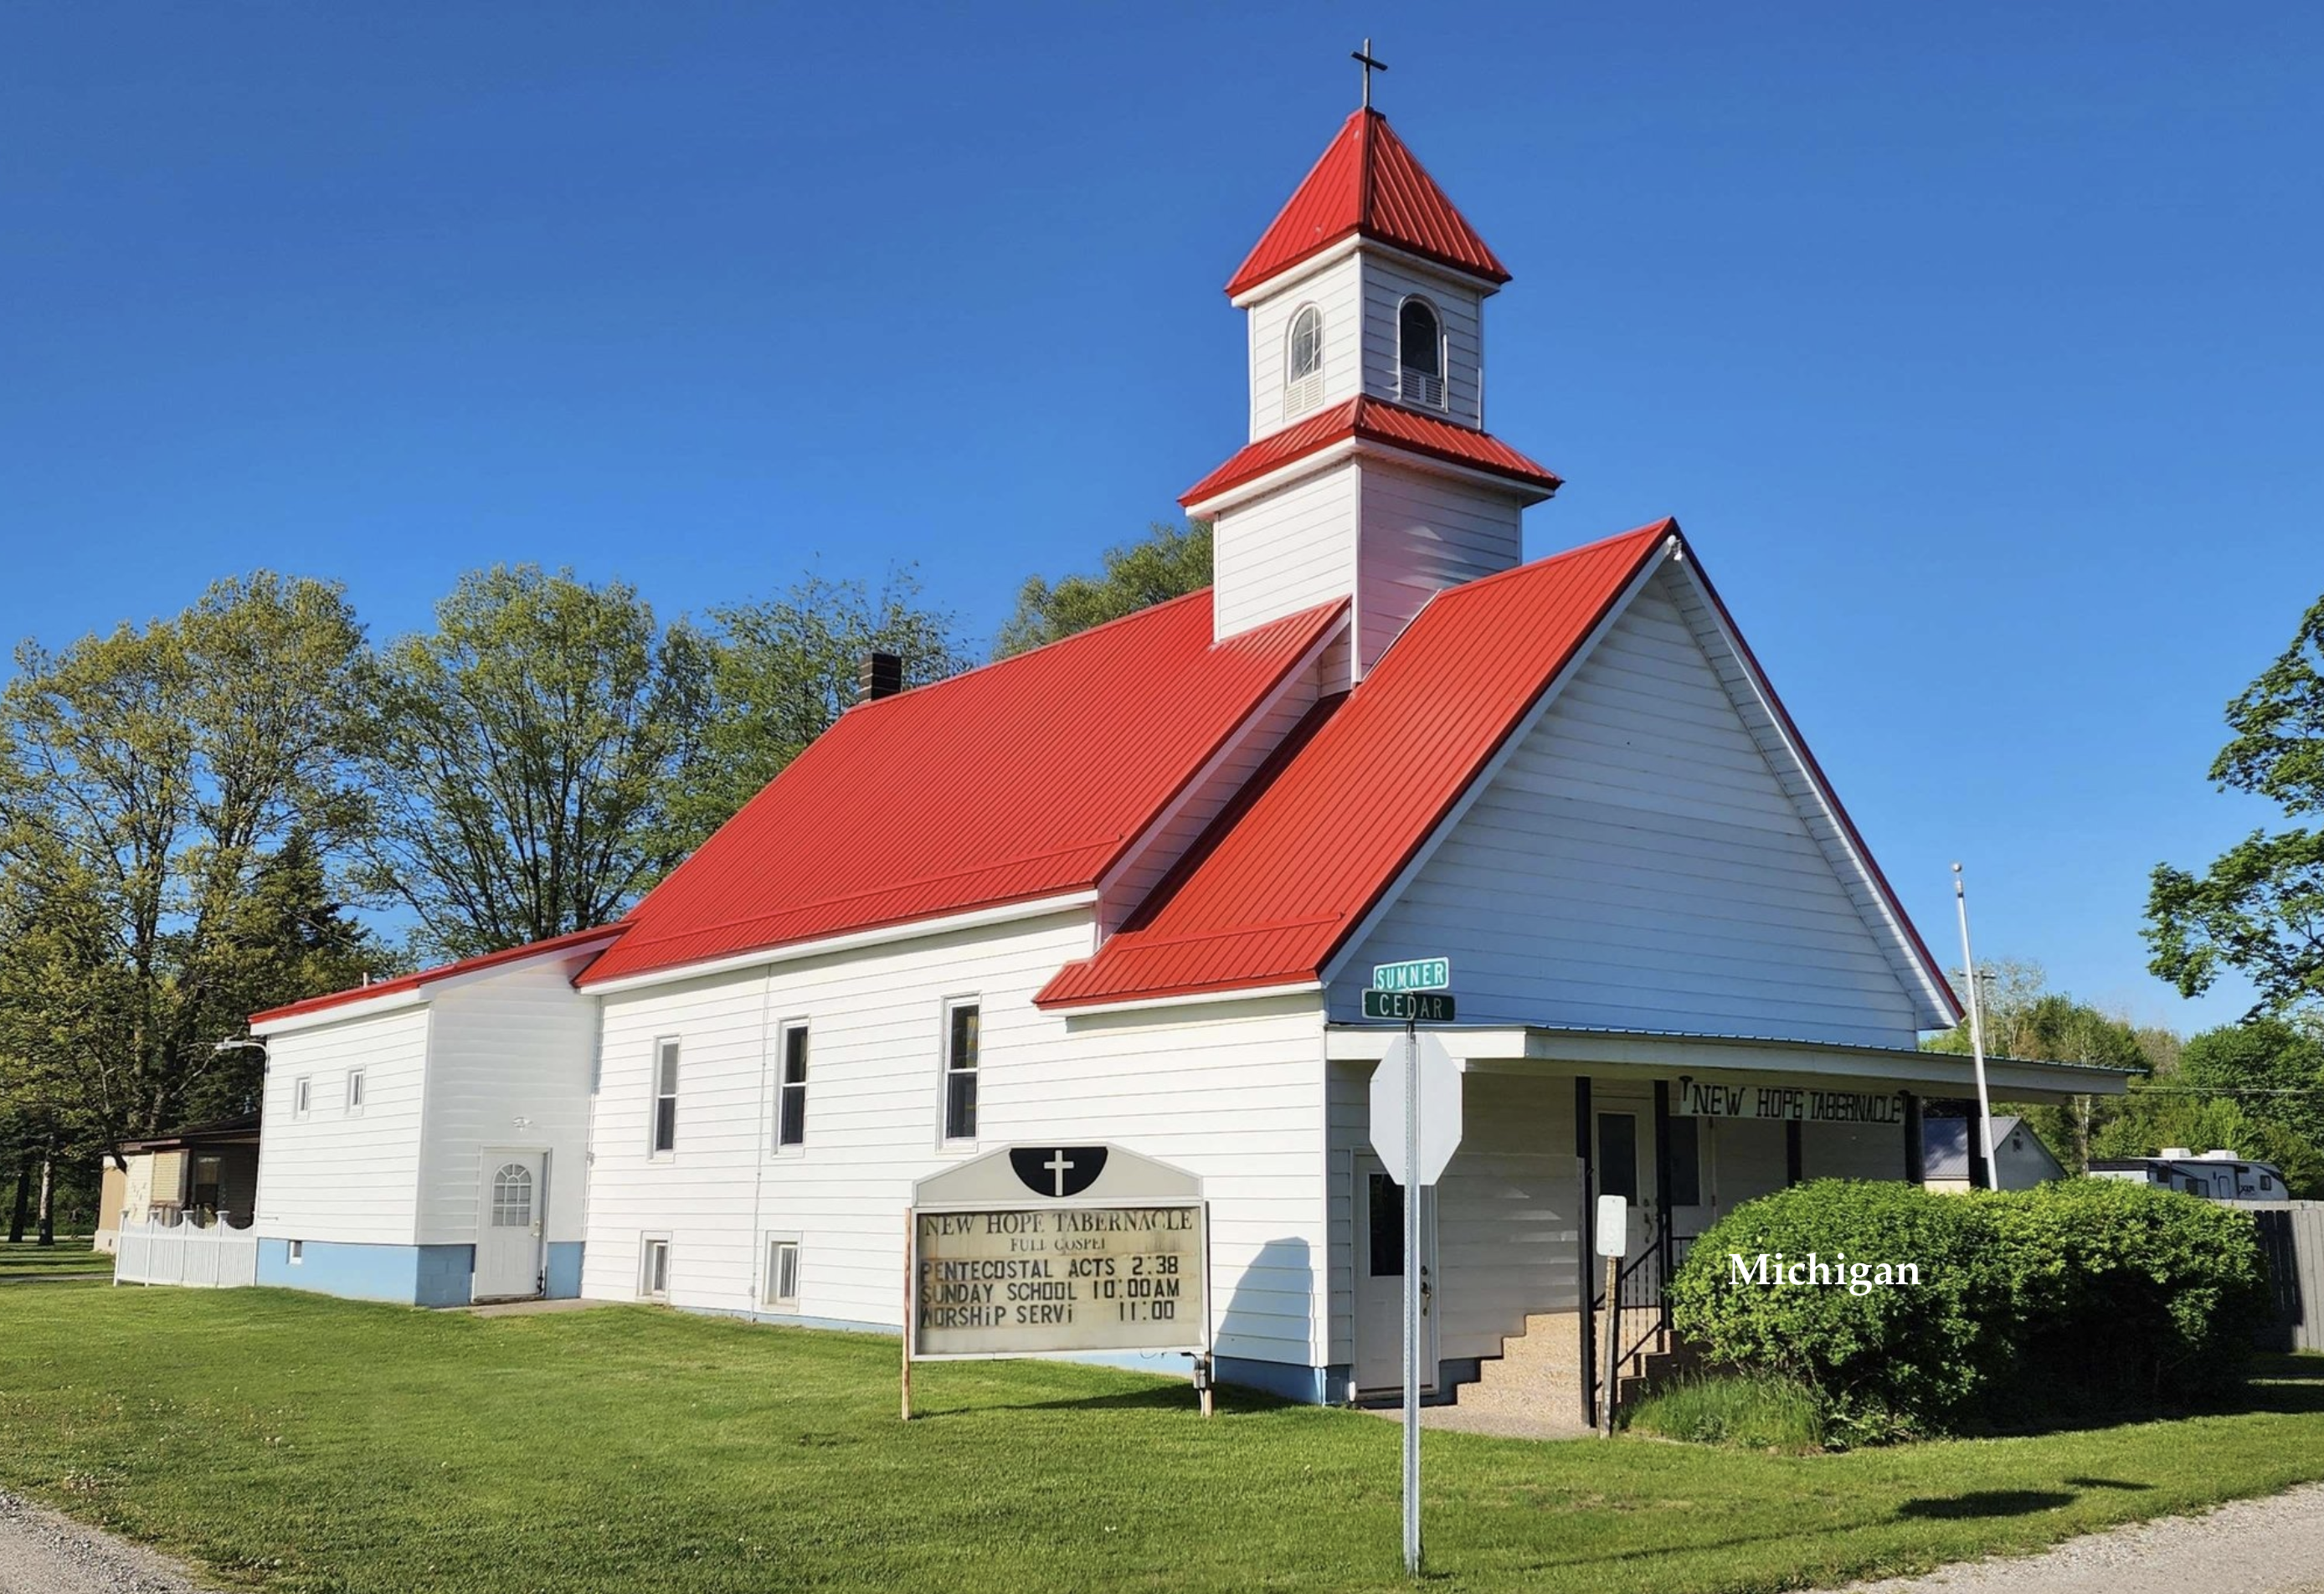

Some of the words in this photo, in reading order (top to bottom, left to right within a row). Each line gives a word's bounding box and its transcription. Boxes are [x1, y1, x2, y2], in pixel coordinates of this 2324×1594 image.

[1376, 963, 1444, 990] SUMNER
[1380, 993, 1442, 1019] CEDAR
[1692, 1084, 1746, 1116] NEW
[1756, 1088, 1804, 1119] HOPE
[1809, 1092, 1902, 1124] TABERNACLE
[925, 1214, 975, 1237] NEW
[986, 1213, 1045, 1235] HOPE
[1052, 1209, 1193, 1232] TABERNACLE
[1010, 1237, 1046, 1252] FULL
[921, 1259, 1054, 1283] PENTECOSTAL
[1068, 1257, 1115, 1278] ACTS
[1132, 1255, 1179, 1276] 2:38
[922, 1283, 994, 1304] SUNDAY
[1007, 1282, 1077, 1301] SCHOOL
[1119, 1300, 1175, 1321] 11:00
